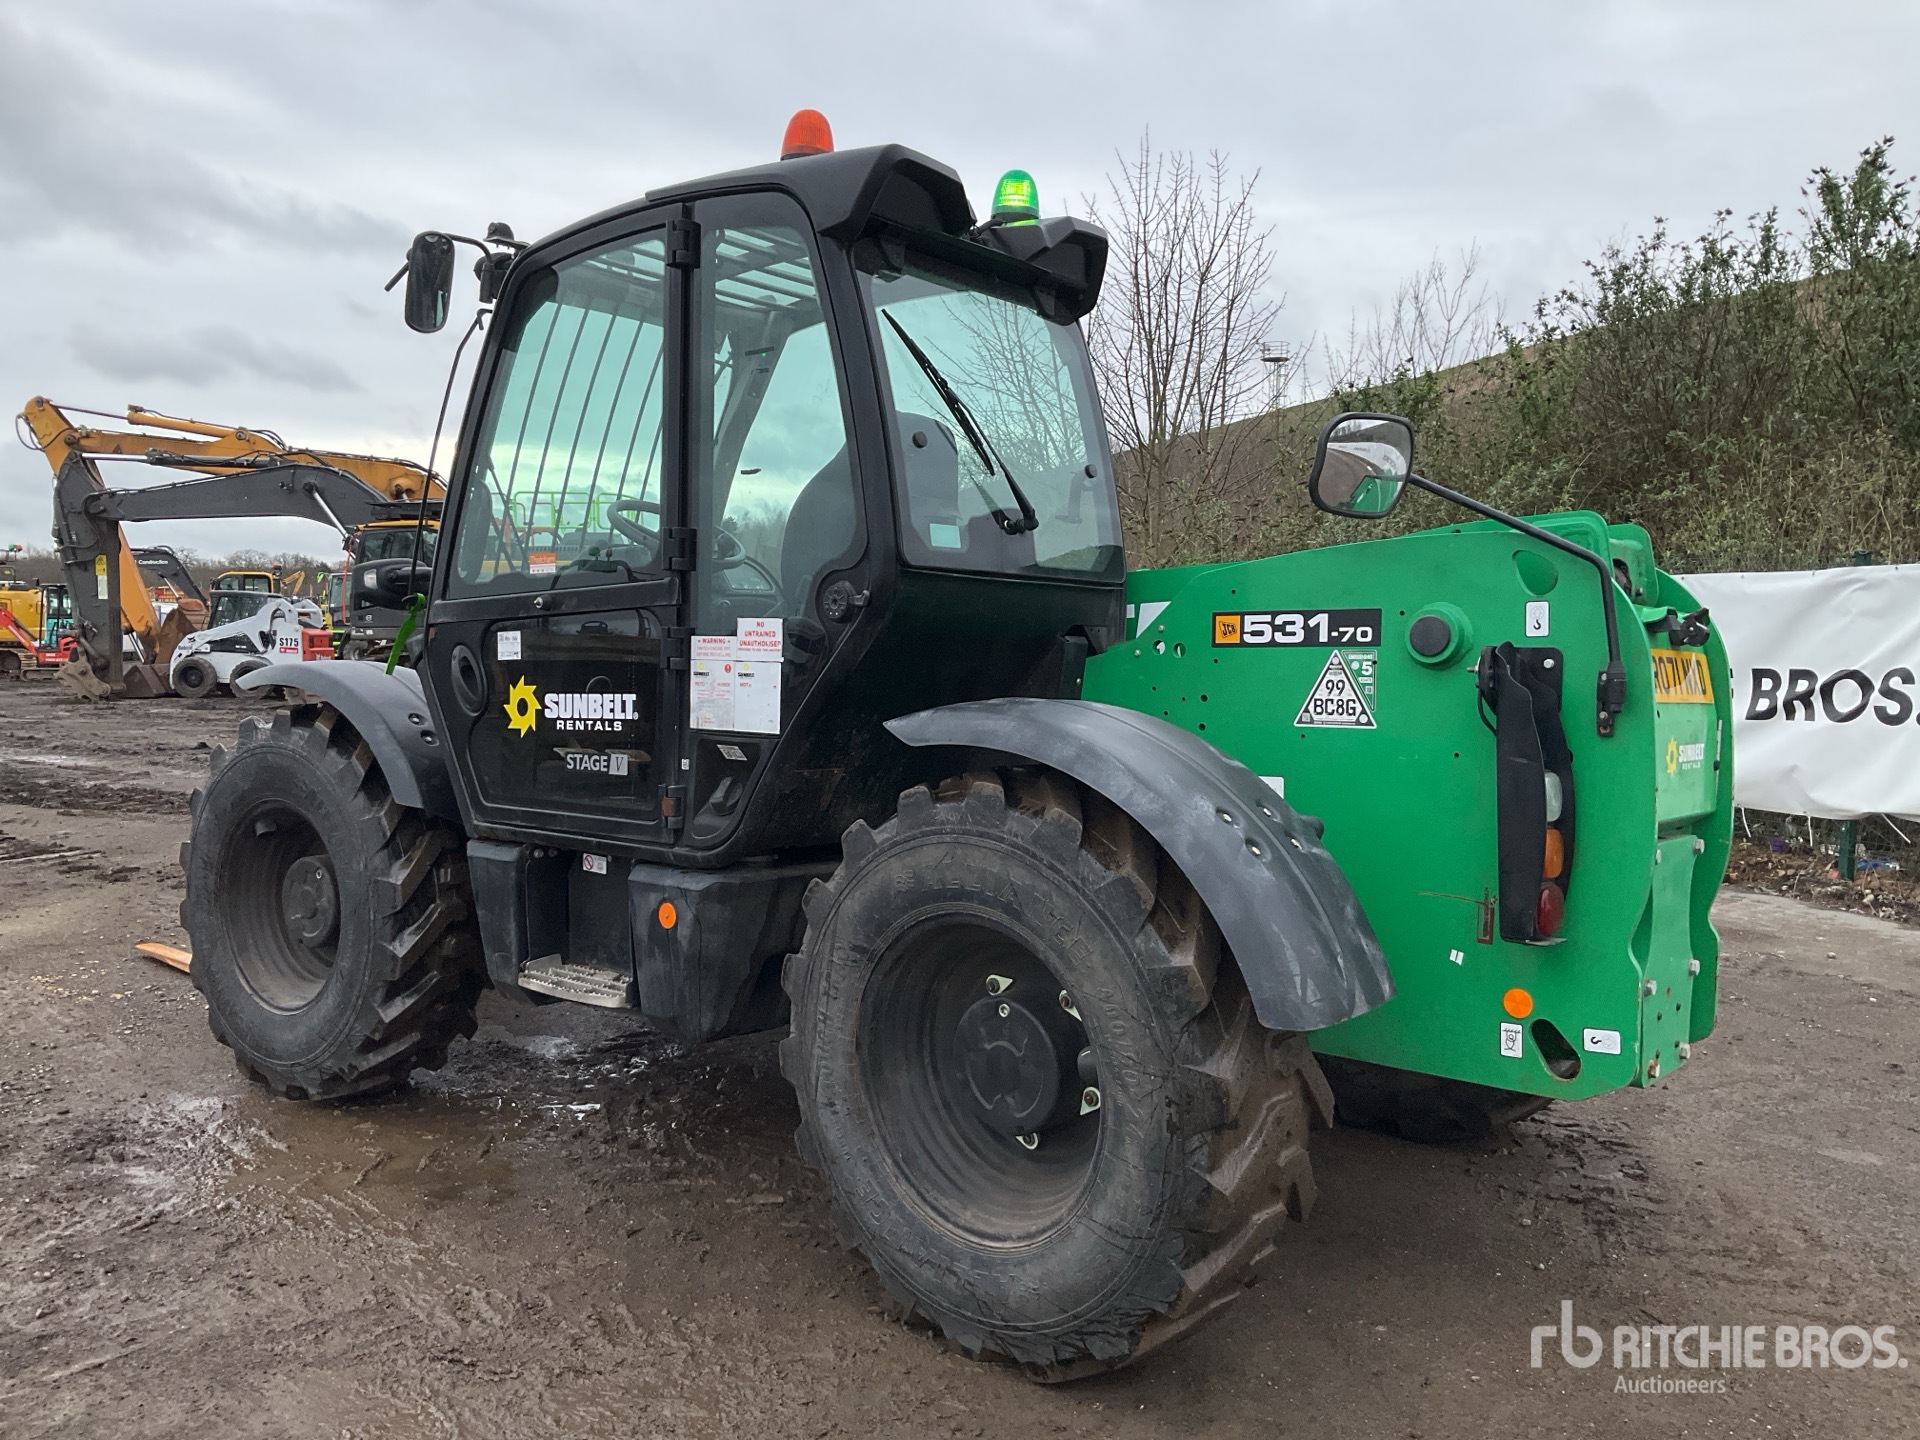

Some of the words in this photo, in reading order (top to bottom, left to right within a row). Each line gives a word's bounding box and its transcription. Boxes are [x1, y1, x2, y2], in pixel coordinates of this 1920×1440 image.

[1222, 622, 1237, 637] JCB
[1243, 613, 1373, 644] 531-70
[279, 637, 299, 647] S175
[1361, 661, 1373, 675] 5
[1325, 679, 1346, 697] 99
[544, 693, 637, 720] SUNBELT
[1313, 698, 1357, 717] BC8G
[556, 720, 622, 732] RENTALS
[1678, 743, 1705, 763] SUNBELT
[566, 753, 608, 772] STAGE
[1681, 762, 1701, 770] RENTALS
